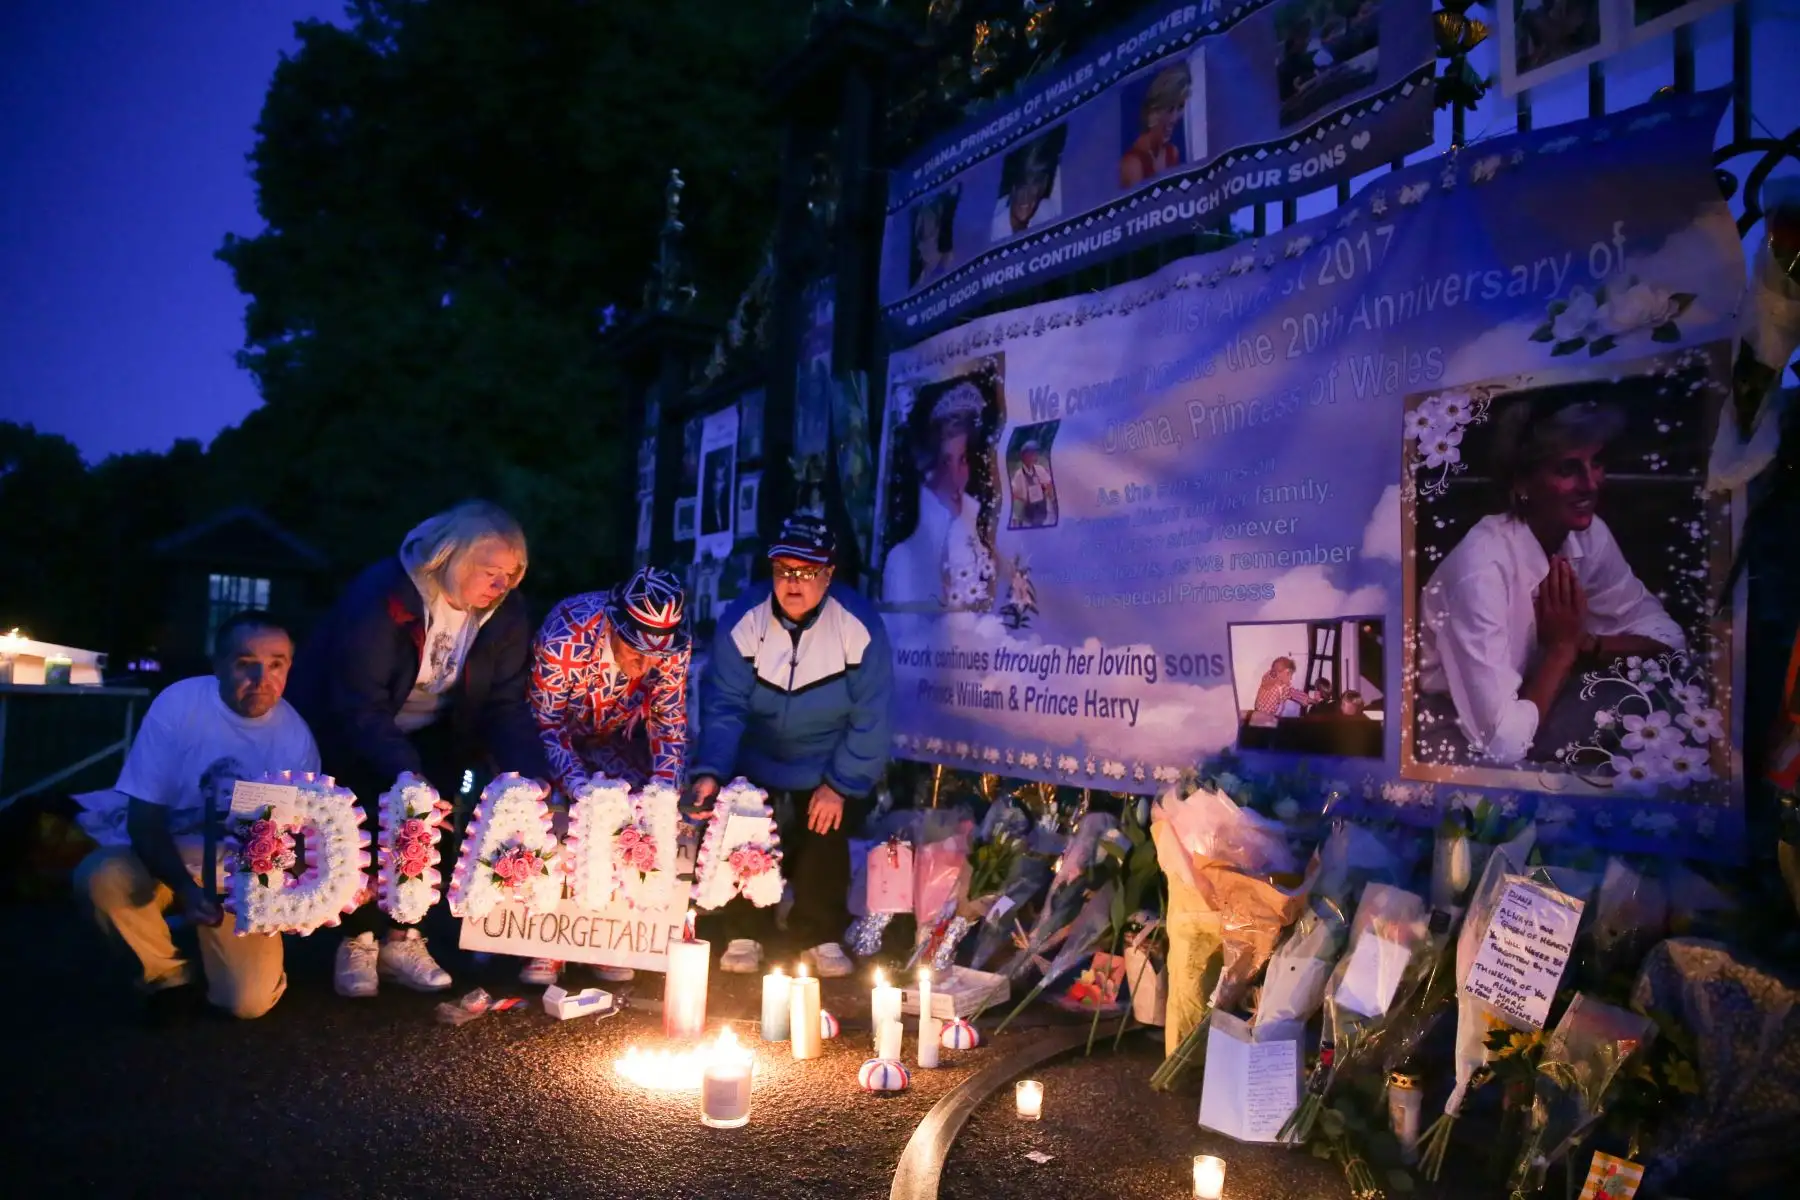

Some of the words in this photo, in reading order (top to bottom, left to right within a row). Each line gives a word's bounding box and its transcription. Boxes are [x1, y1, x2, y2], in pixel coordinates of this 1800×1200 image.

[1023, 93, 1043, 115] OF
[1045, 63, 1095, 102] WALES
[1116, 4, 1197, 61] FOREVER
[920, 297, 947, 324] YOUR
[948, 280, 980, 308] GOOD
[981, 260, 1025, 290] WORK
[1028, 225, 1122, 273] CONTINUES
[1125, 189, 1220, 237] THROUGH
[1220, 168, 1282, 201] YOUR
[1288, 143, 1348, 183] SONS
[1317, 223, 1396, 287] 2017
[1028, 384, 1060, 422] We
[1225, 331, 1276, 373] the
[1281, 304, 1345, 361] 20th
[1347, 250, 1574, 334] Anniversary
[1589, 219, 1627, 280] of
[1185, 385, 1302, 440] Princess
[1309, 359, 1340, 407] of
[1347, 346, 1445, 400] Wales
[1229, 544, 1356, 571] remember
[1178, 581, 1276, 603] Princess
[896, 646, 932, 668] work
[993, 646, 1061, 681] through
[1065, 648, 1095, 674] her
[1098, 646, 1158, 684] loving
[1164, 651, 1226, 678] sons
[956, 681, 1005, 711] William
[1008, 693, 1020, 711] &
[1024, 686, 1079, 716] Prince
[1084, 689, 1140, 727] Harry
[483, 908, 683, 955] UNFORGETABLE
